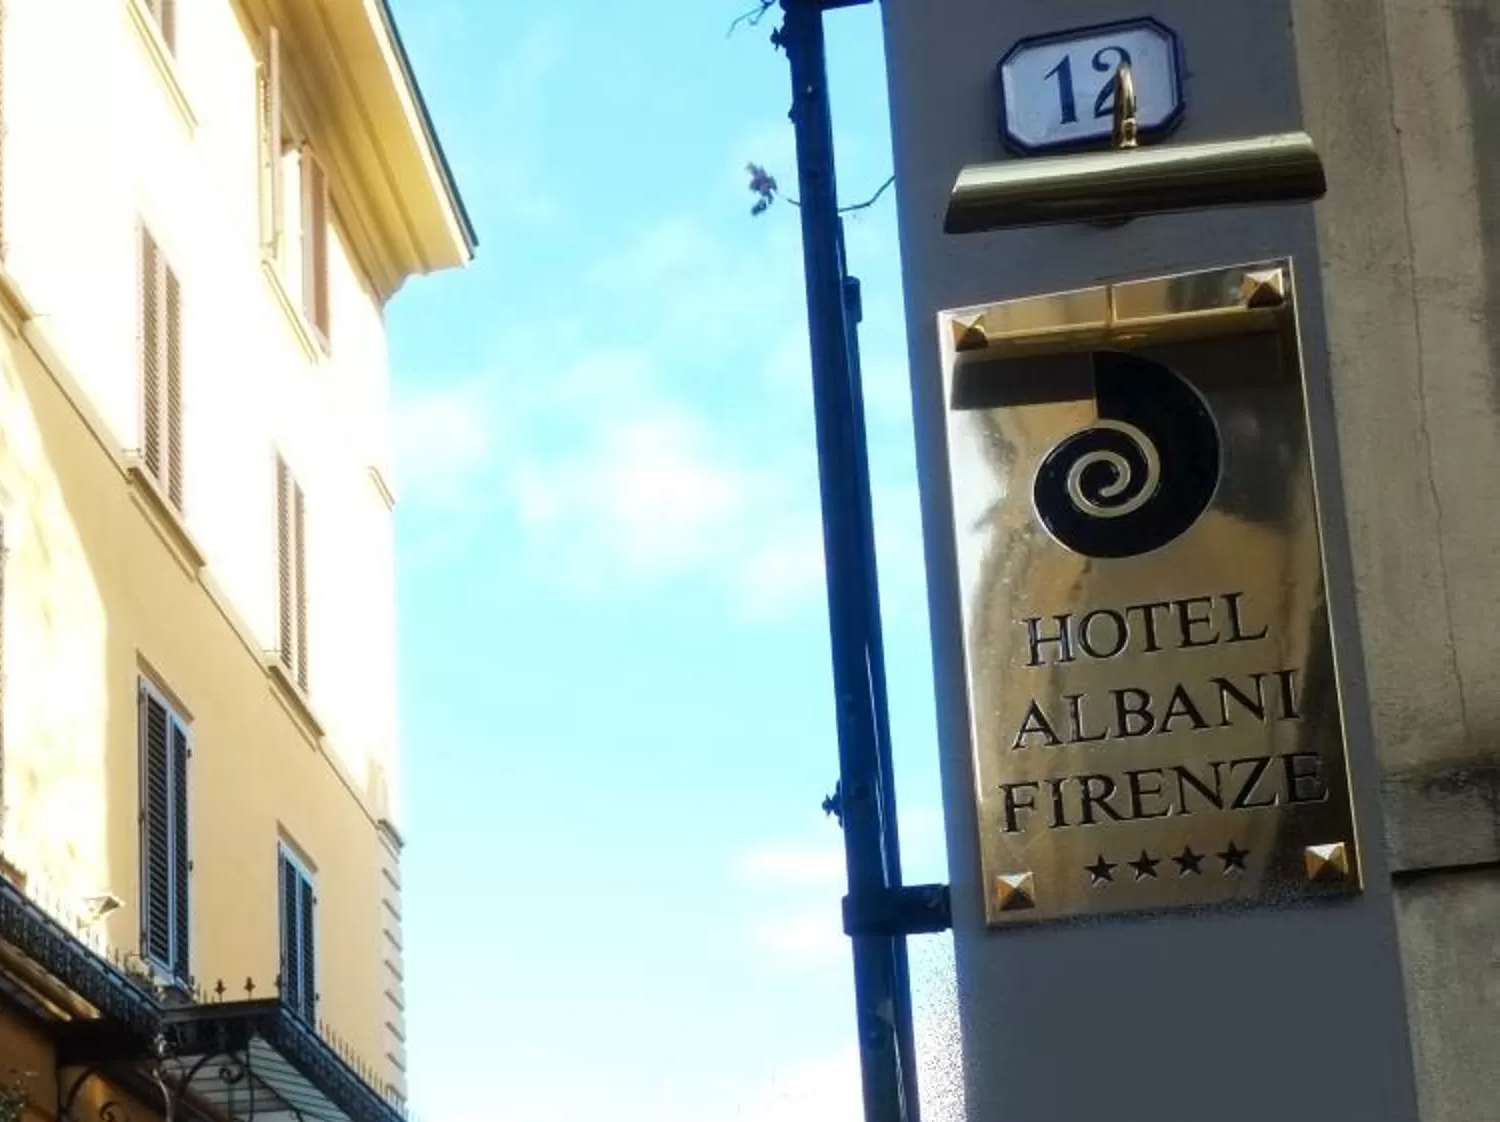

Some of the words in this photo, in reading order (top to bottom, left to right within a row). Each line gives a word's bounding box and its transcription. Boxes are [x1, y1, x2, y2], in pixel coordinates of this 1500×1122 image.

[1043, 45, 1132, 125] 12
[1021, 591, 1269, 668] HOTEL
[1011, 667, 1302, 751] ALBANI
[997, 751, 1330, 834] FIRENZE
